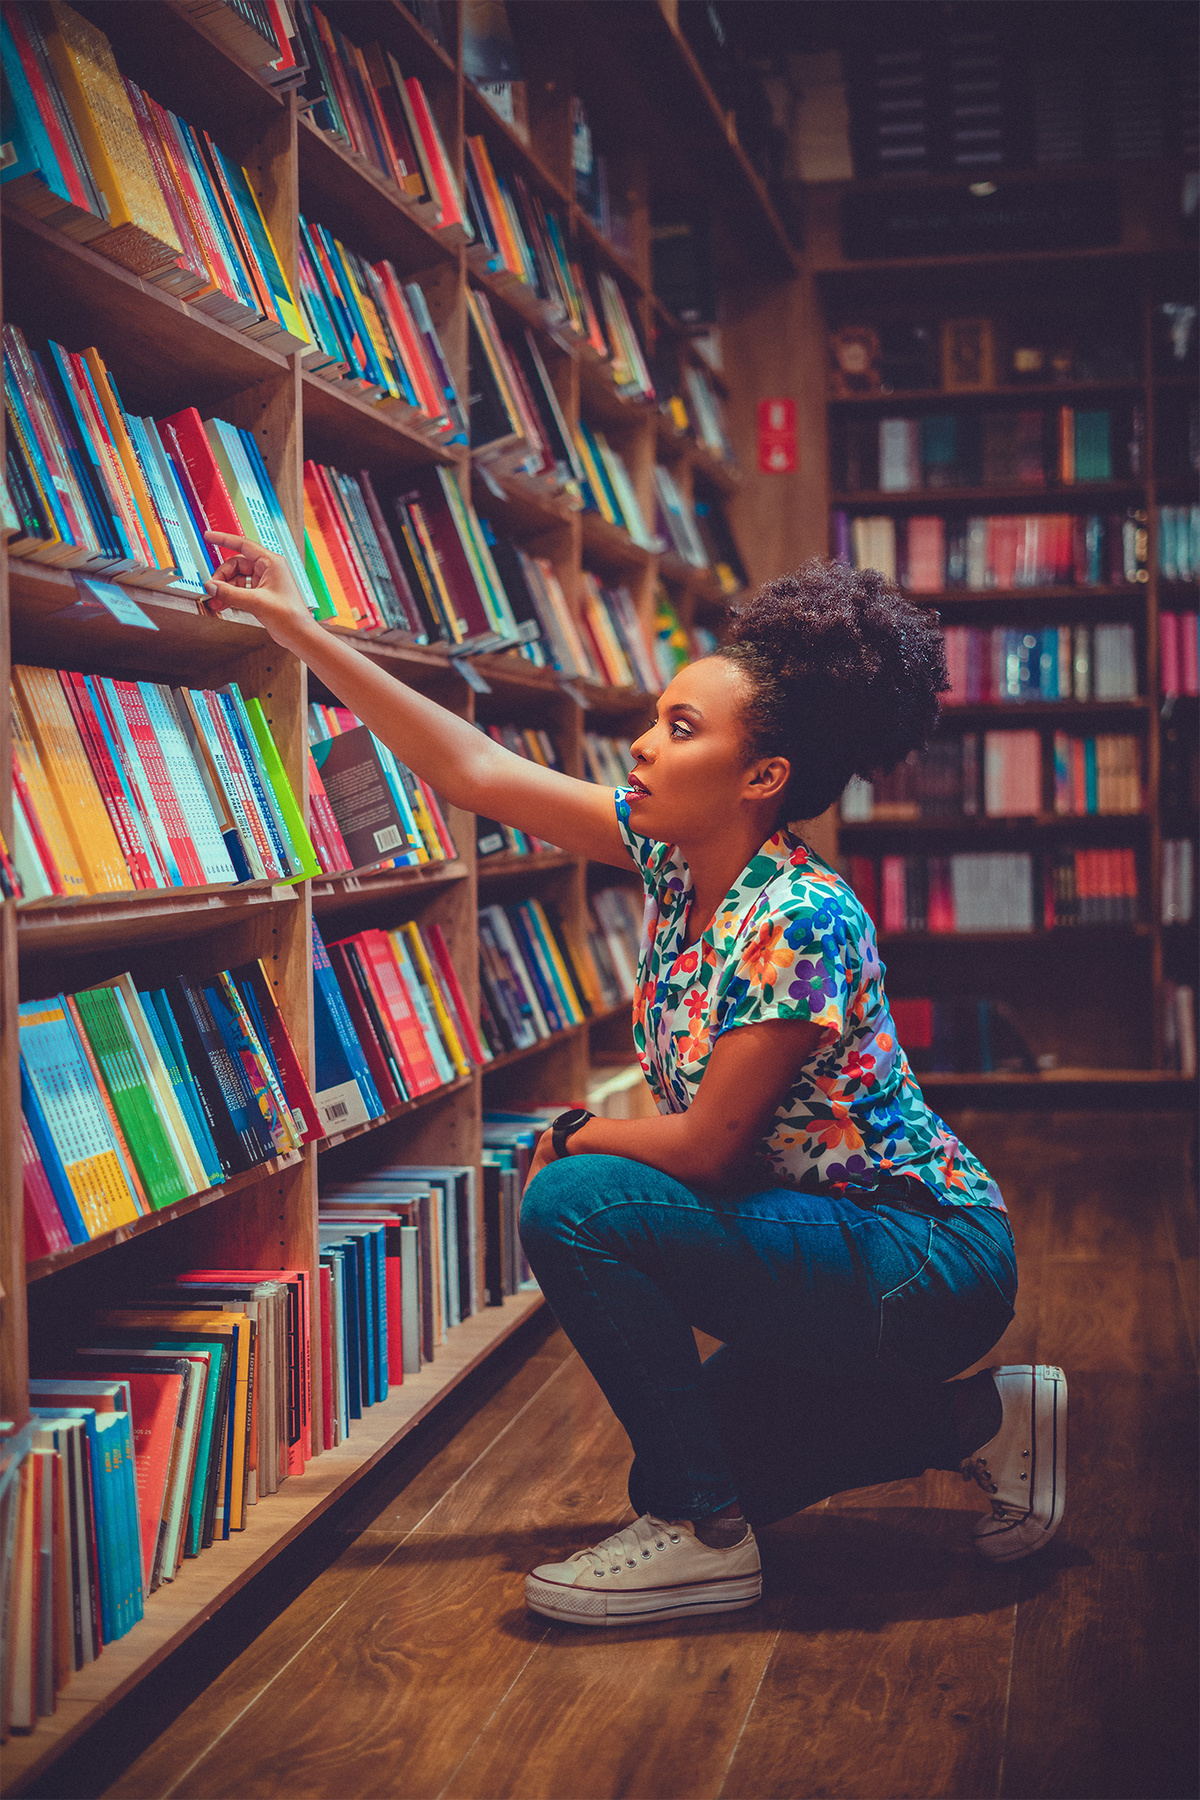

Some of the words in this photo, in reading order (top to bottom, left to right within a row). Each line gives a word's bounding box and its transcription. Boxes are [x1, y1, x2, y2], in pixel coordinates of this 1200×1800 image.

[108, 444, 117, 463] ESTE
[116, 465, 128, 492] BARCO
[133, 512, 144, 538] TODOS
[122, 705, 131, 724] COSTA
[127, 706, 136, 725] COSTA
[131, 707, 141, 726] COSTA
[136, 706, 145, 725] COSTA
[140, 707, 148, 725] COSTA
[239, 747, 255, 784] PADRÃO
[253, 786, 260, 798] DE
[258, 800, 280, 854] EXCELÊNCIA
[243, 747, 260, 783] PADRÃO
[257, 785, 265, 798] DE
[262, 800, 284, 854] EXCELÊNCIA
[266, 778, 279, 808] ADRIANA
[230, 797, 239, 813] PARA
[105, 796, 131, 855] LIDERANÇA
[114, 794, 139, 854] LIDERANÇA
[121, 795, 145, 854] LIDERANÇA
[251, 810, 271, 856] PROSPERIDADE
[71, 1005, 86, 1038] RENATO
[83, 1039, 101, 1080] GRINBERG
[261, 1060, 289, 1113] WILL
[68, 1121, 78, 1144] VALOR
[75, 1119, 85, 1142] VALOR
[81, 1117, 92, 1140] VALOR
[89, 1115, 99, 1137] VALOR
[95, 1113, 106, 1135] VALOR
[118, 1134, 130, 1157] ALFA
